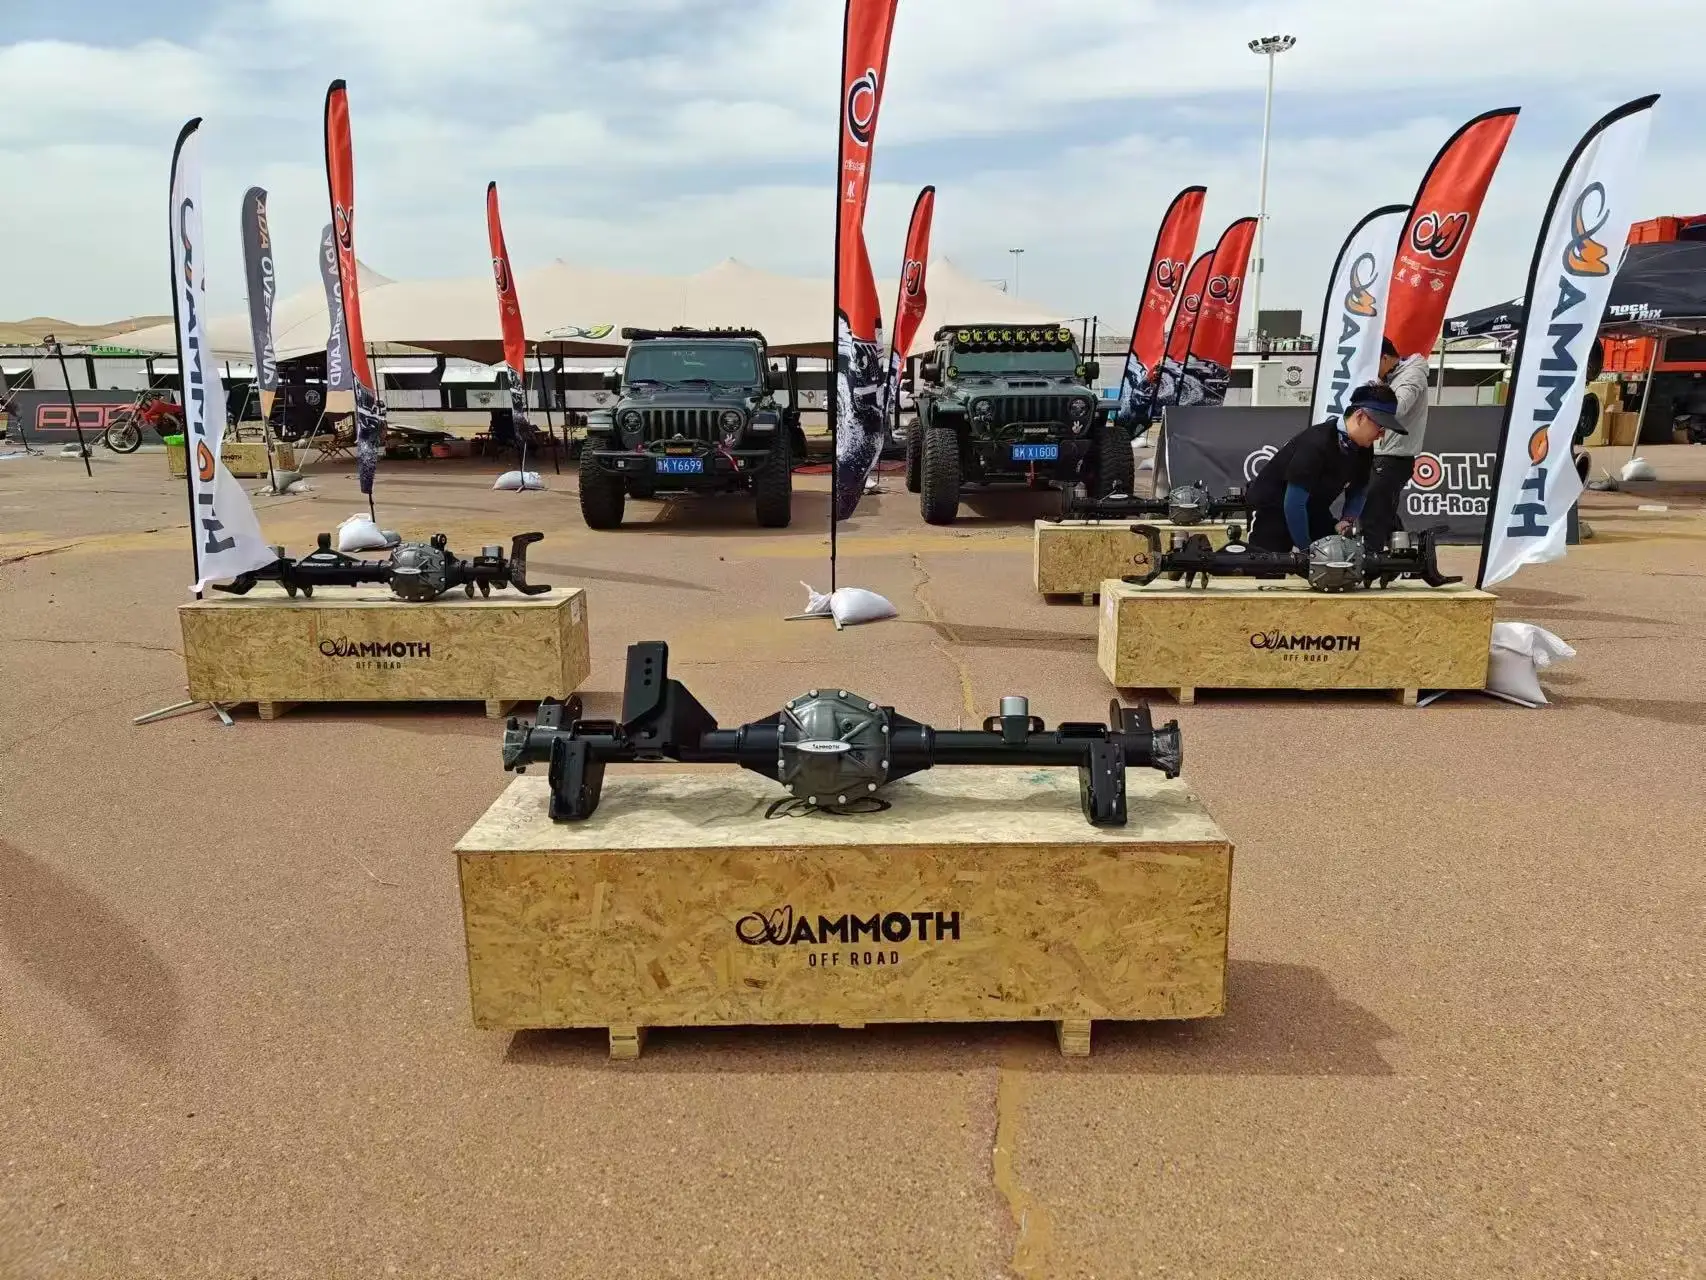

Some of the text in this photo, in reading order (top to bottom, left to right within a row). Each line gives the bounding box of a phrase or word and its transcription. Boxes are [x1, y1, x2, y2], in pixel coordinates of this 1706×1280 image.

[1407, 493, 1490, 516] Off-Roa
[1303, 654, 1329, 662] ROAD
[808, 951, 899, 967] OFF ROAD
